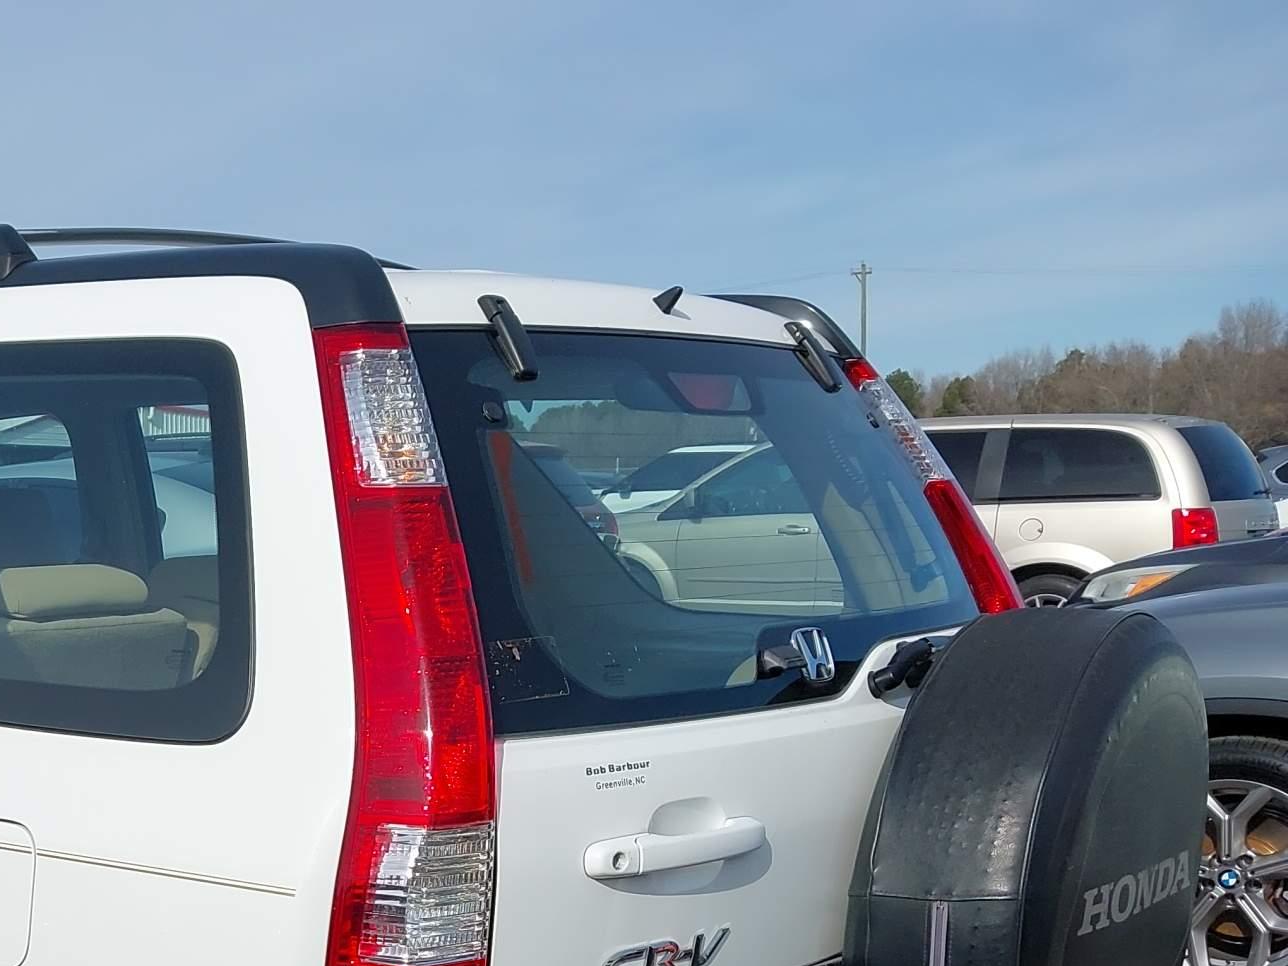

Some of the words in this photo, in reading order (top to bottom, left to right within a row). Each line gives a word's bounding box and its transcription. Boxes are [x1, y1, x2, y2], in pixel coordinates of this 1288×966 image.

[585, 766, 607, 776] Bob
[607, 761, 651, 773] Barbour
[595, 778, 635, 790] Greenville,
[635, 775, 646, 785] NC
[1077, 850, 1191, 937] HONDA
